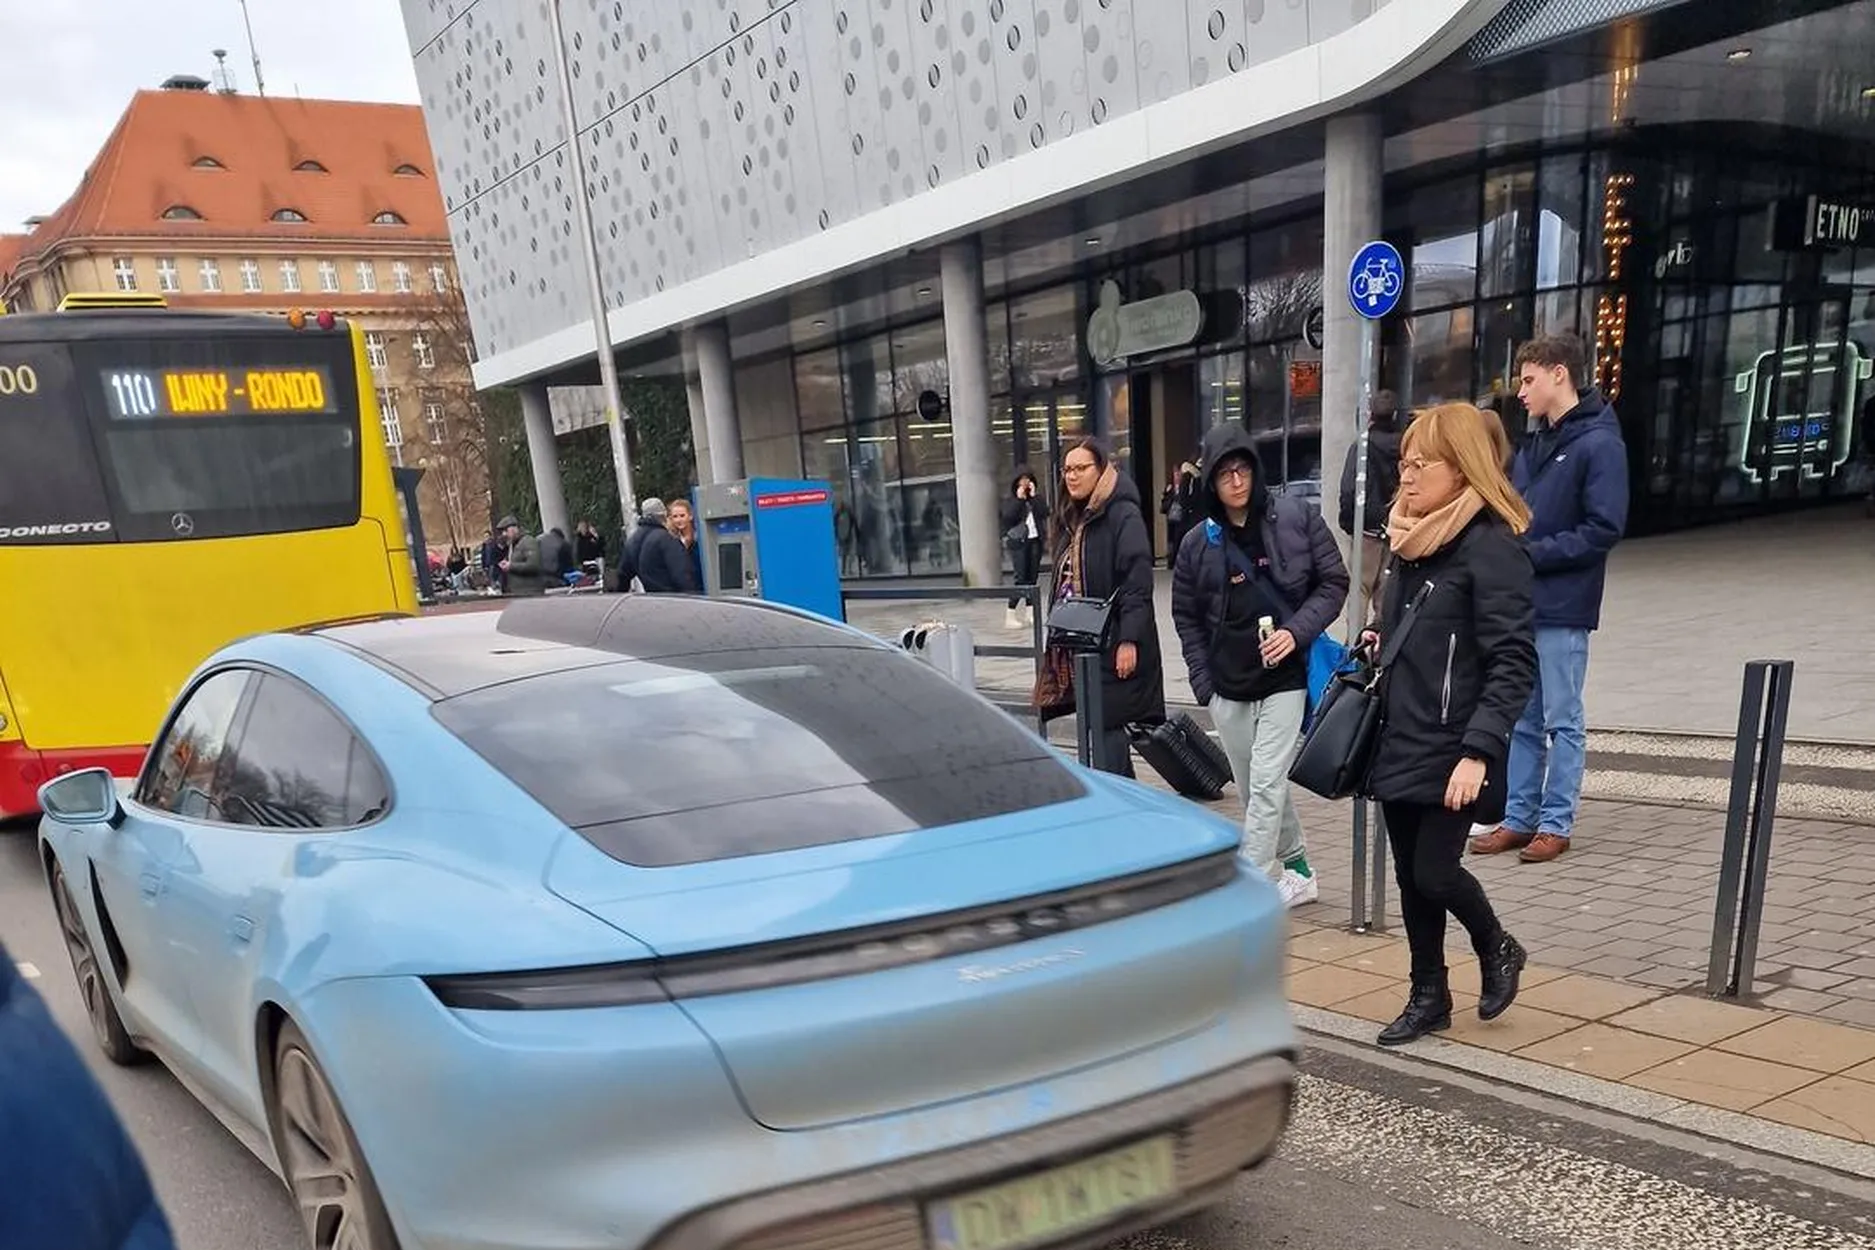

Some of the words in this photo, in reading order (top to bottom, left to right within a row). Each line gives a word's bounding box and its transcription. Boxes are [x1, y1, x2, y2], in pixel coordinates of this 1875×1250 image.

[1817, 203, 1859, 240] ETNO
[111, 373, 156, 415] 110
[247, 370, 325, 410] RONDO
